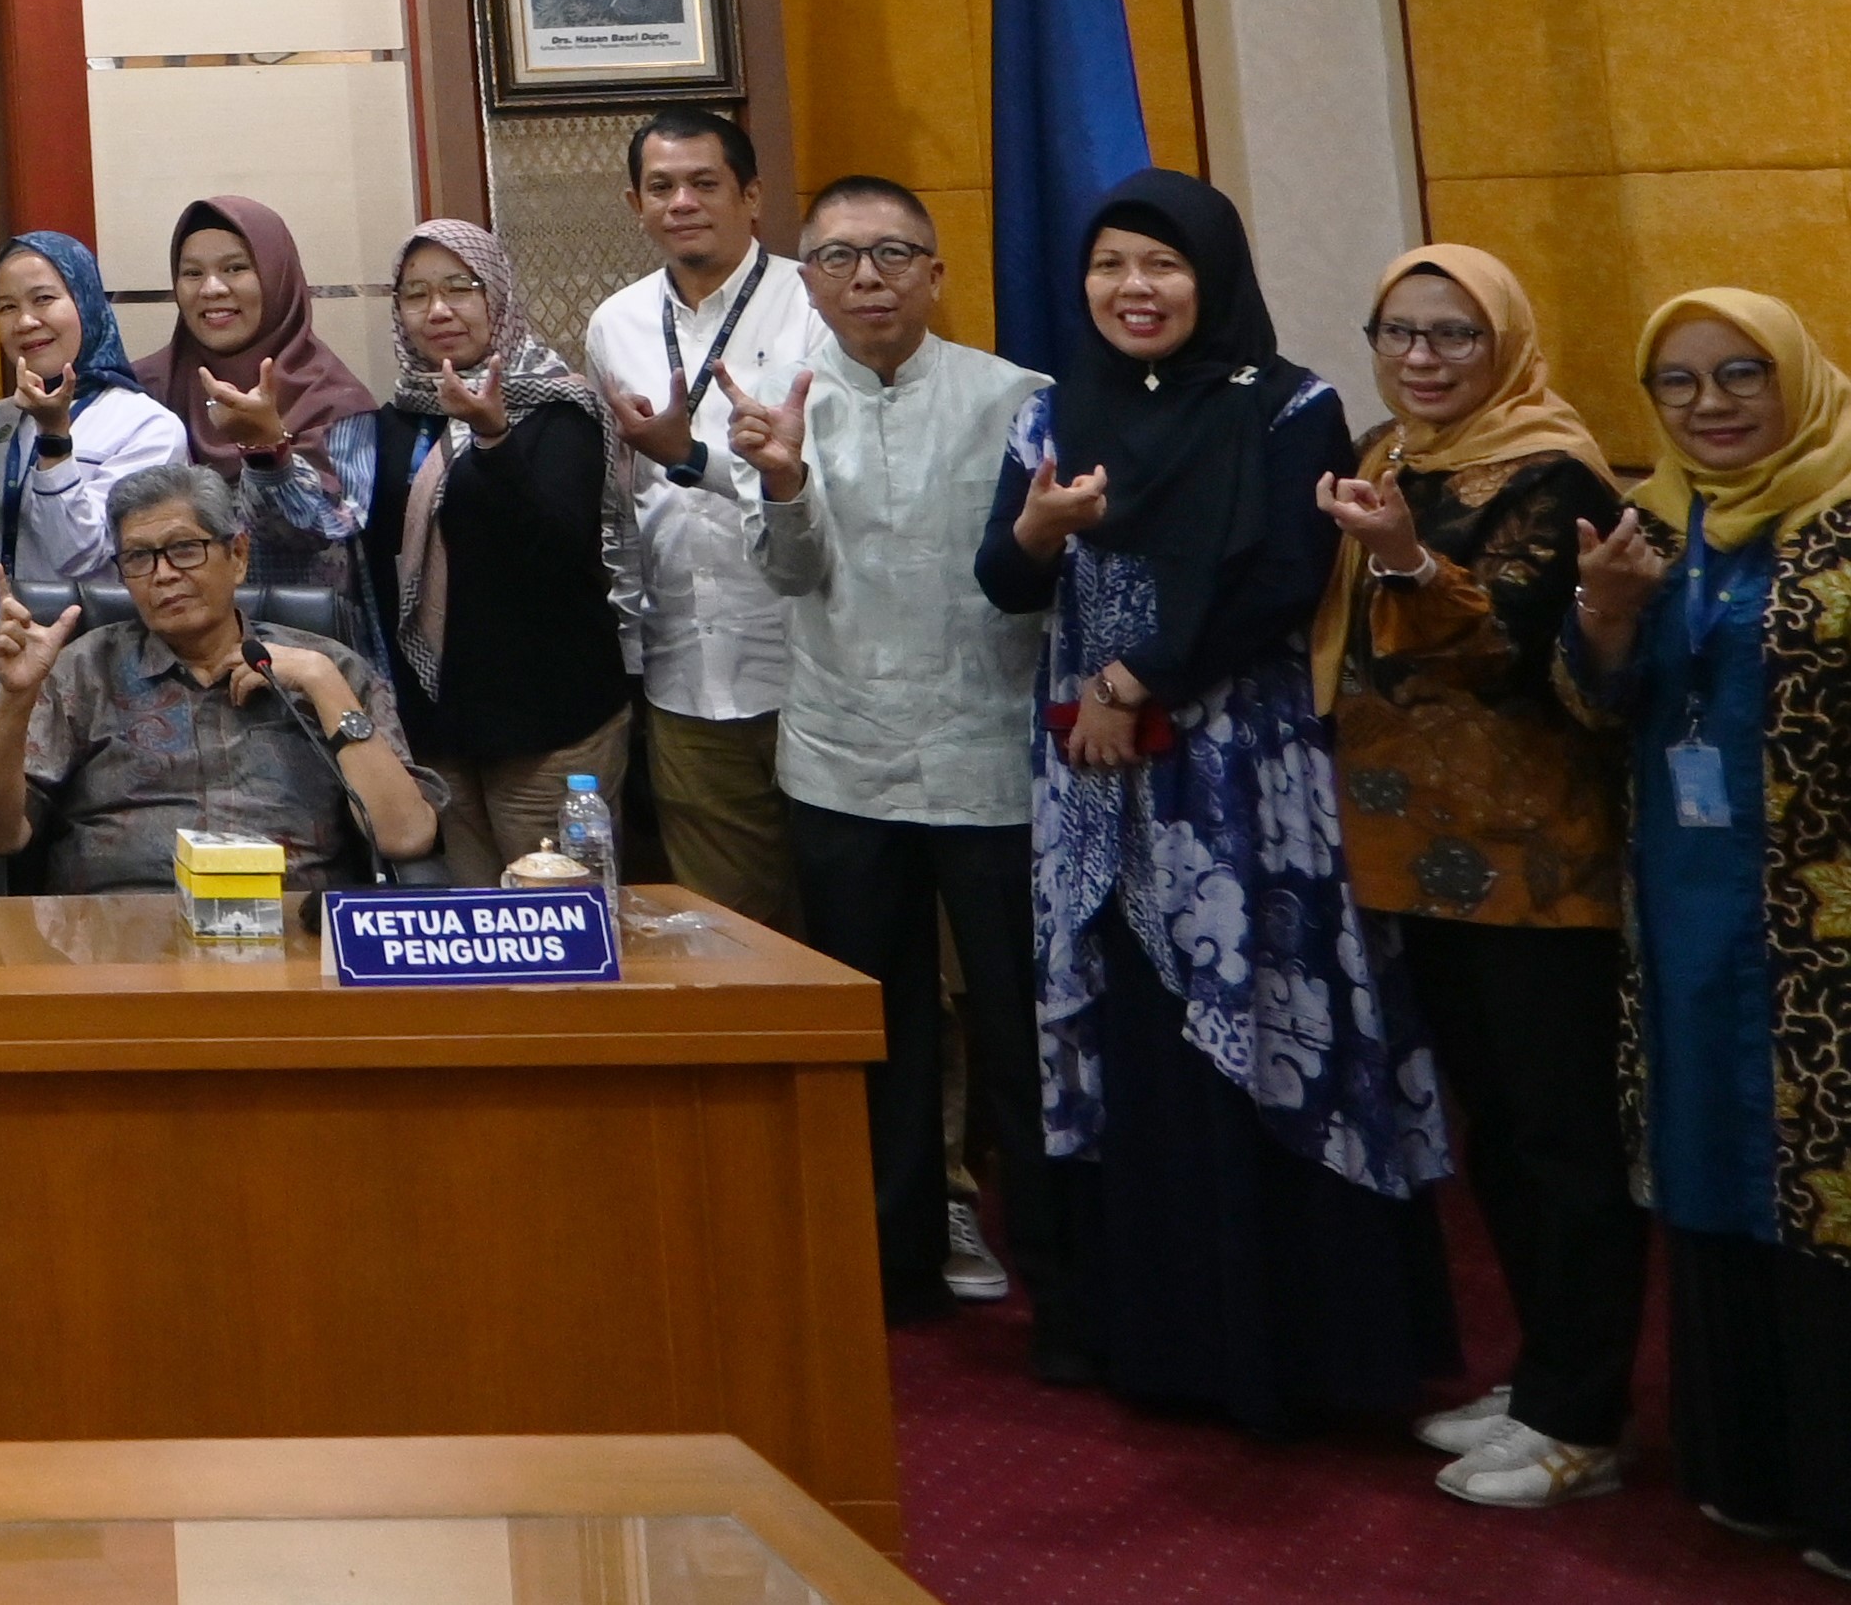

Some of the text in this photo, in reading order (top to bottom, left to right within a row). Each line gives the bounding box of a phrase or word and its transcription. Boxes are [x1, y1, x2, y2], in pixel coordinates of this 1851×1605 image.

[575, 35, 608, 43] Hasan
[611, 32, 639, 42] Basri
[641, 32, 669, 41] Durin
[352, 905, 586, 936] KETUA BADAN
[383, 936, 565, 965] PENGURUS
